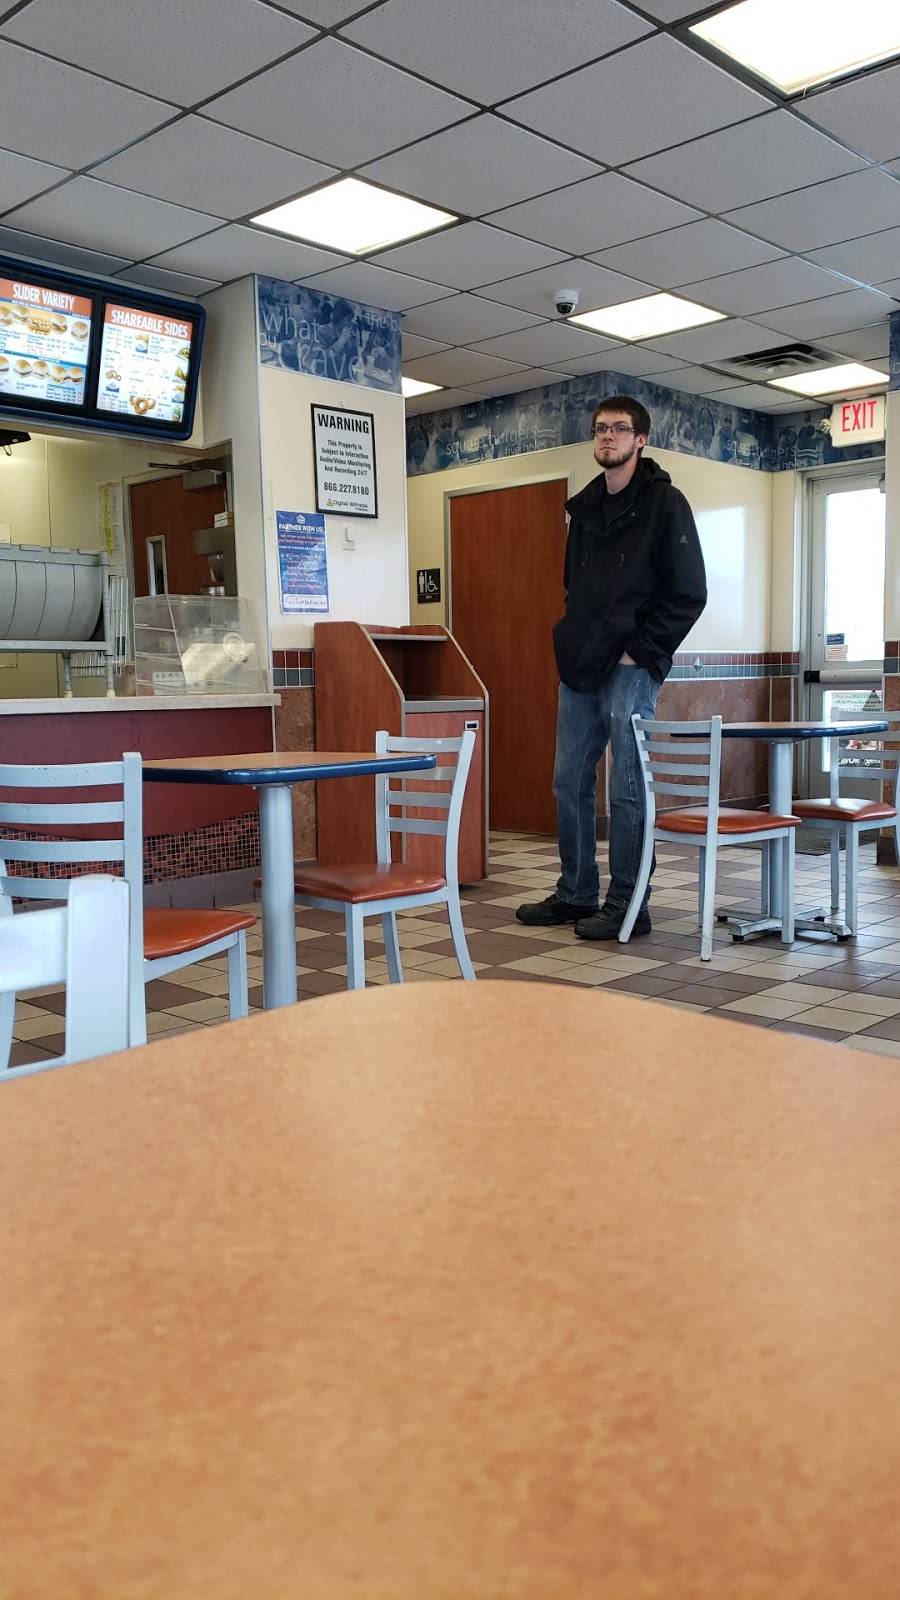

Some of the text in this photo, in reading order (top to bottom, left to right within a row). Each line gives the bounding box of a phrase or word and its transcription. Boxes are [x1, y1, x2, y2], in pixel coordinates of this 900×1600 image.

[12, 283, 40, 304] SLIDER
[41, 289, 75, 311] VARIETY
[111, 309, 189, 338] SHAREABLE SIDES
[262, 303, 319, 343] what
[317, 413, 370, 434] WARNING
[841, 400, 877, 432] EXIT
[327, 439, 337, 447] This
[338, 441, 357, 451] Property
[321, 447, 338, 456] Subject
[345, 450, 369, 460] Interactive
[334, 466, 357, 476] Recording
[347, 459, 372, 470] Monitoring
[323, 481, 370, 496] 866.227.8180
[279, 523, 302, 532] PARTNER
